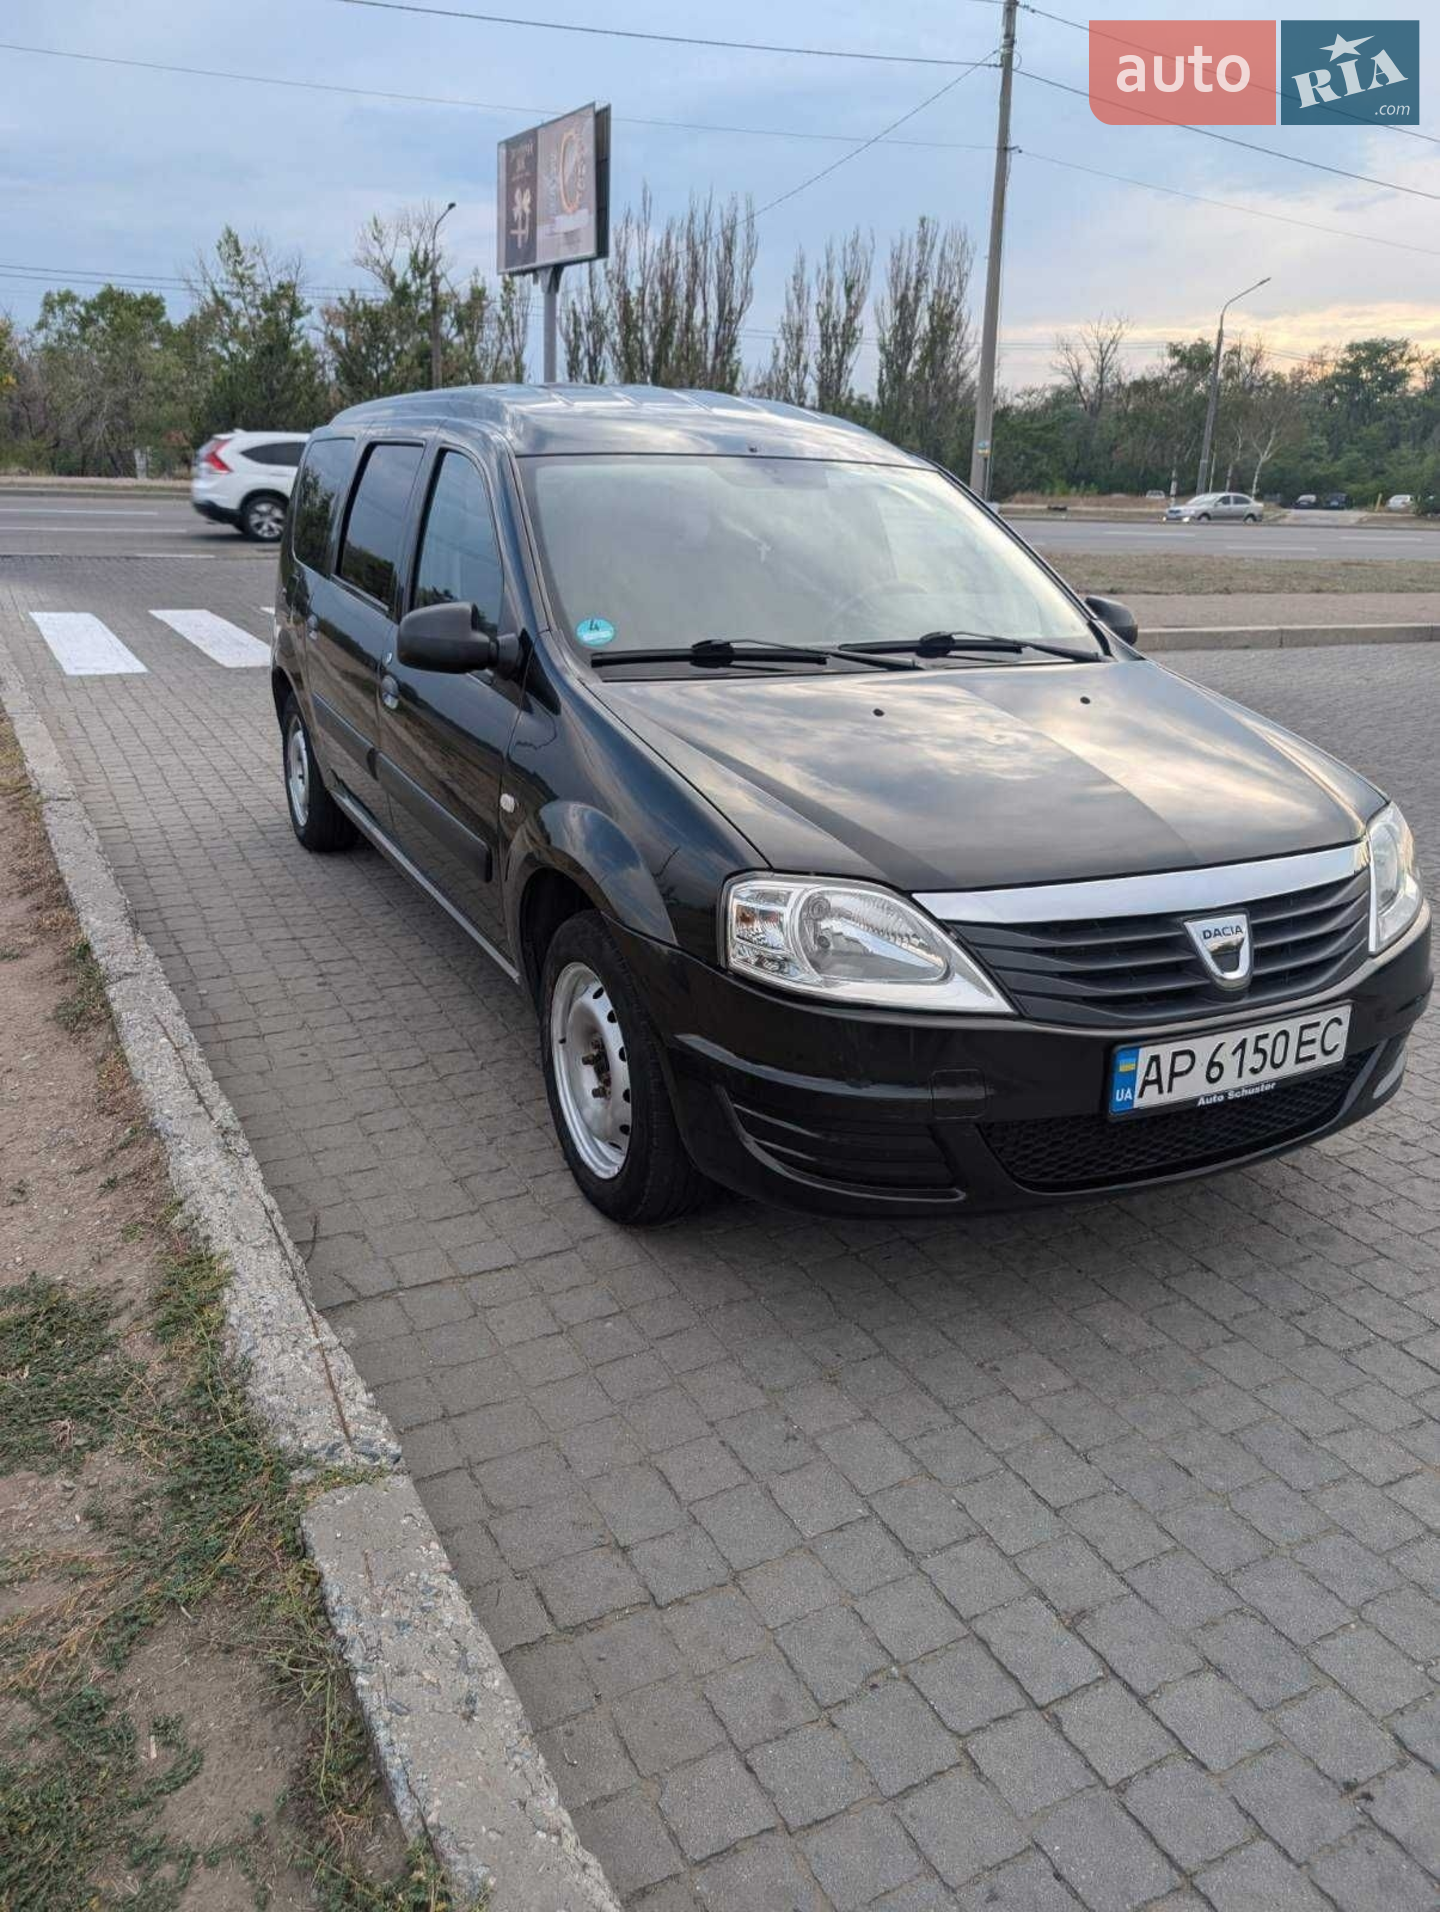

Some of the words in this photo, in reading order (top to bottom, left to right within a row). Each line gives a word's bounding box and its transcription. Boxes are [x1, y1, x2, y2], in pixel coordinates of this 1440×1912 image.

[1202, 925, 1243, 940] DACIA
[1137, 1048, 1196, 1099] AP
[1205, 1029, 1290, 1084] 6150
[1294, 1016, 1343, 1065] EC
[1115, 1089, 1133, 1102] UA
[1196, 1094, 1225, 1107] Auto
[1227, 1081, 1277, 1100] Schuster
